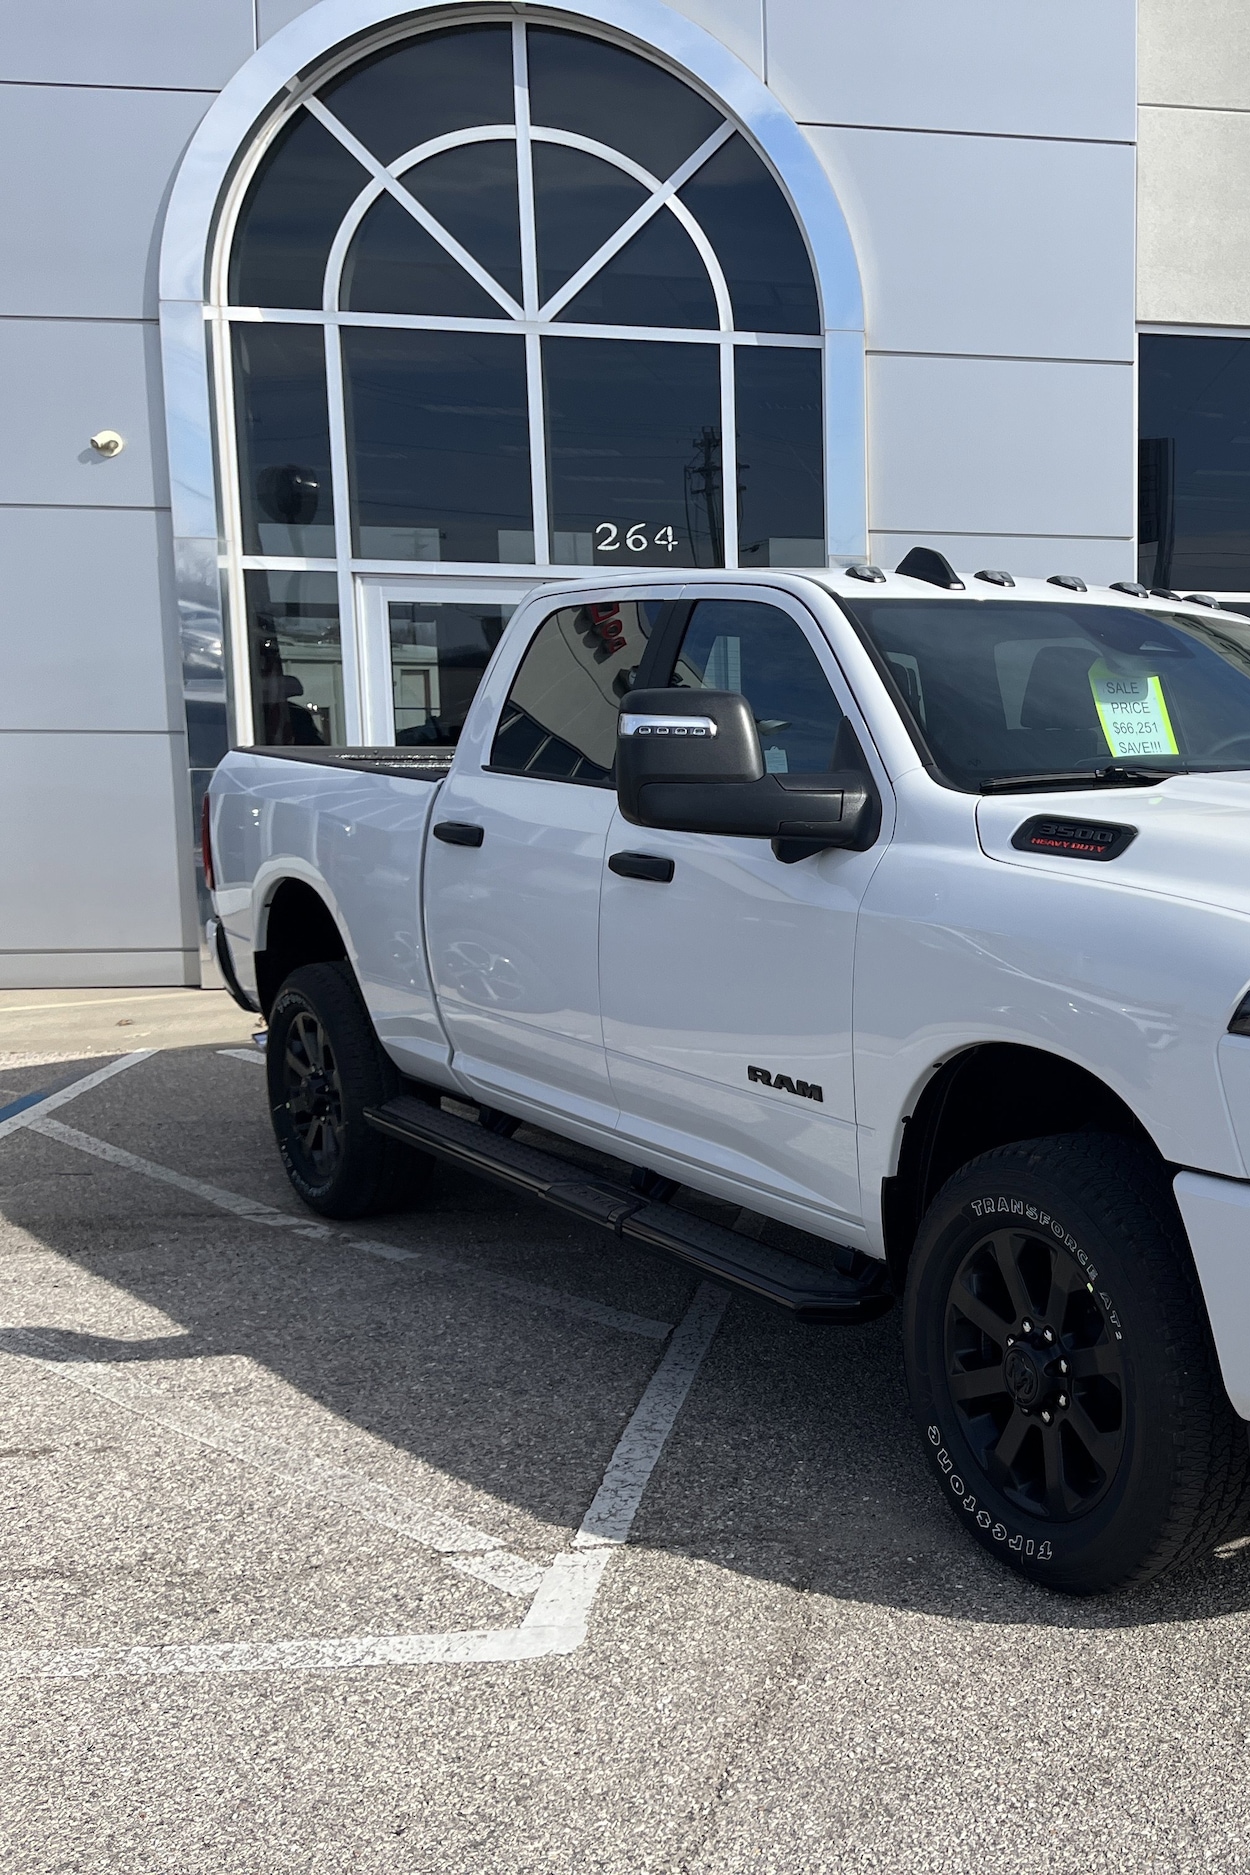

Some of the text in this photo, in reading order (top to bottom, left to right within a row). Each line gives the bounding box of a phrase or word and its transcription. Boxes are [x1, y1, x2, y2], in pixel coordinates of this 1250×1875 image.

[595, 522, 679, 552] 264
[1106, 681, 1140, 695] SALE
[1111, 701, 1151, 714] PRICE
[1113, 721, 1158, 735] $66,251
[1118, 741, 1163, 754] SAVE!!!
[1040, 823, 1114, 843] 3500
[1031, 838, 1108, 853] HEAVY DUTY
[747, 1065, 824, 1103] RAM
[971, 1197, 1098, 1280] TRANSFORCE
